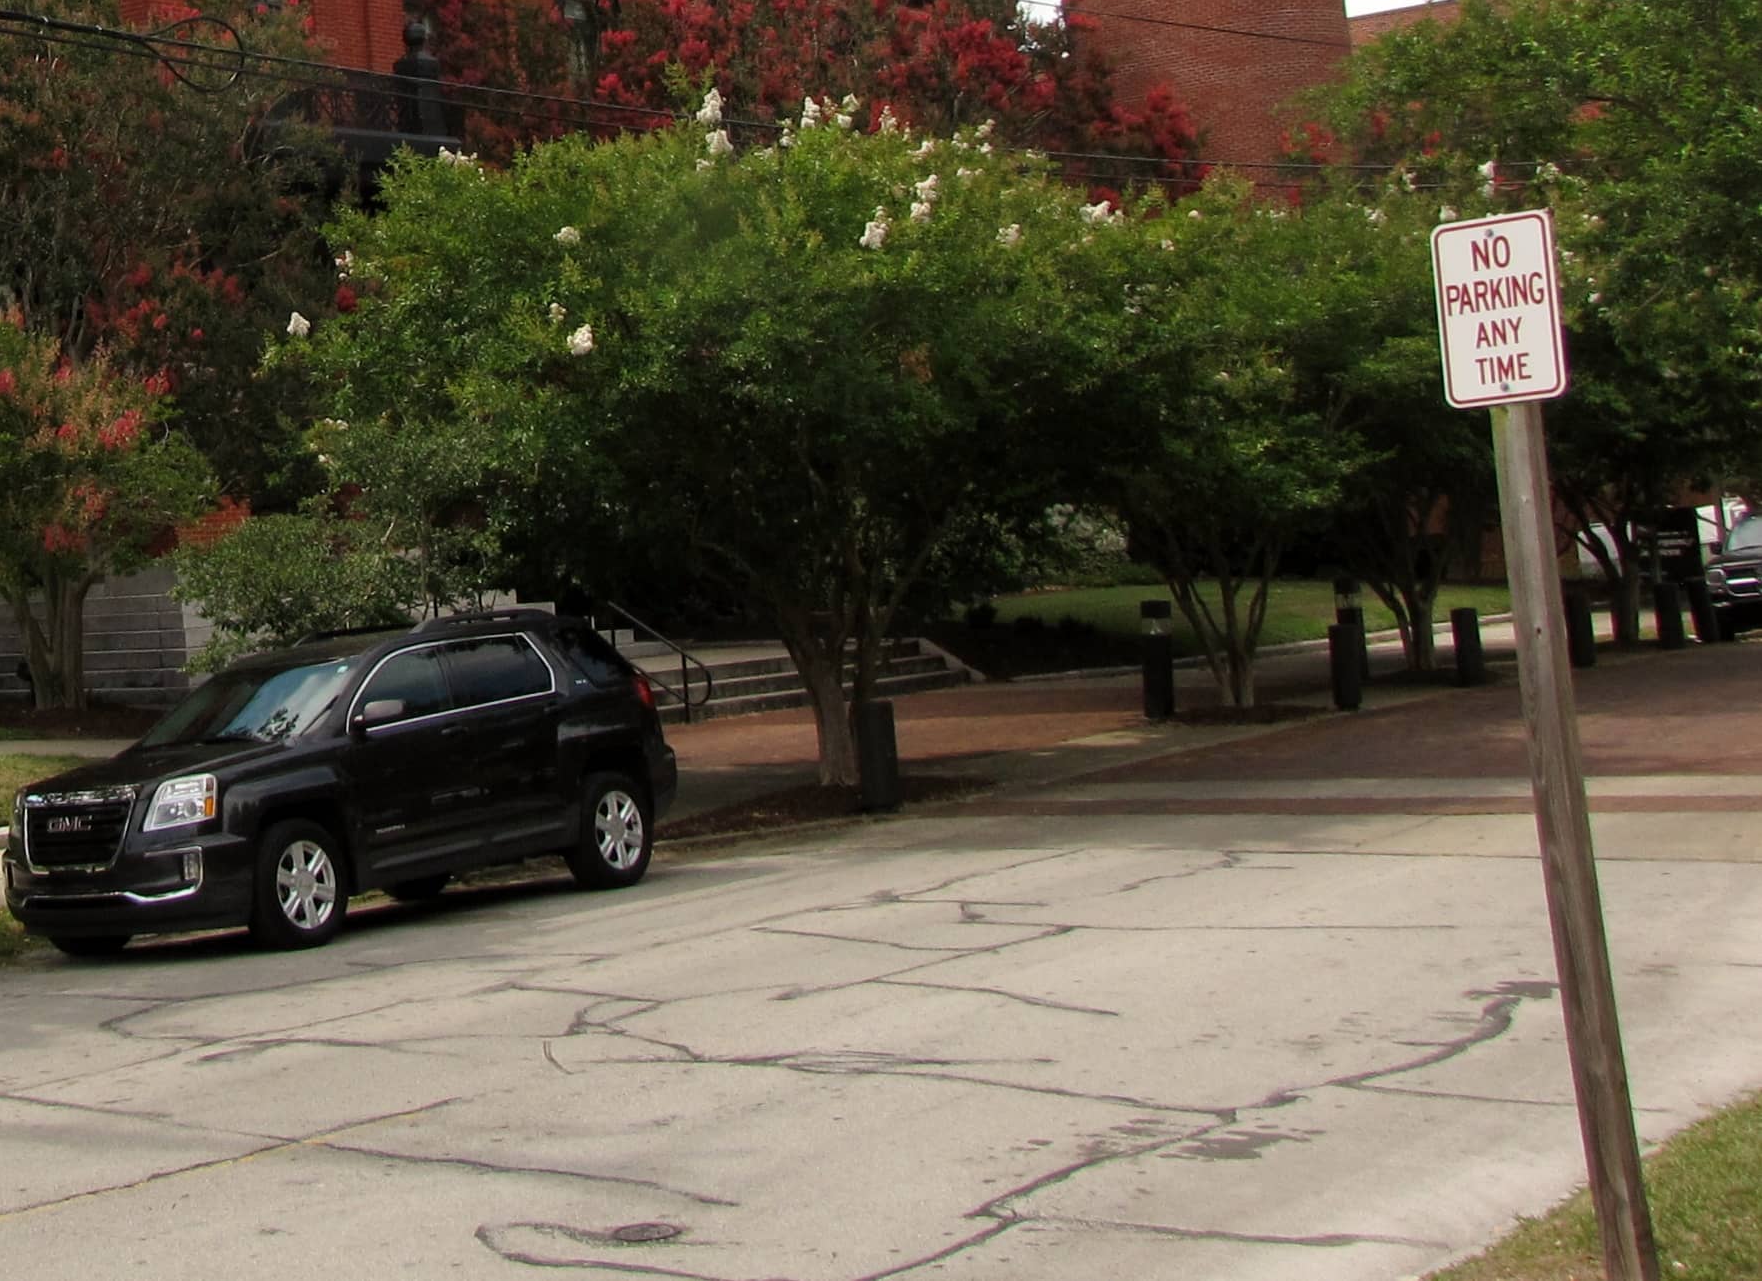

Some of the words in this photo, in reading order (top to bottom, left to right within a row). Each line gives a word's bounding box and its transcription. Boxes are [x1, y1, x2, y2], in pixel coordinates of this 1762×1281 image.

[1471, 235, 1511, 272] NO
[1445, 271, 1545, 317] PARKING
[1476, 316, 1523, 349] ANY
[1475, 352, 1532, 385] TIME
[48, 815, 93, 833] GMC
